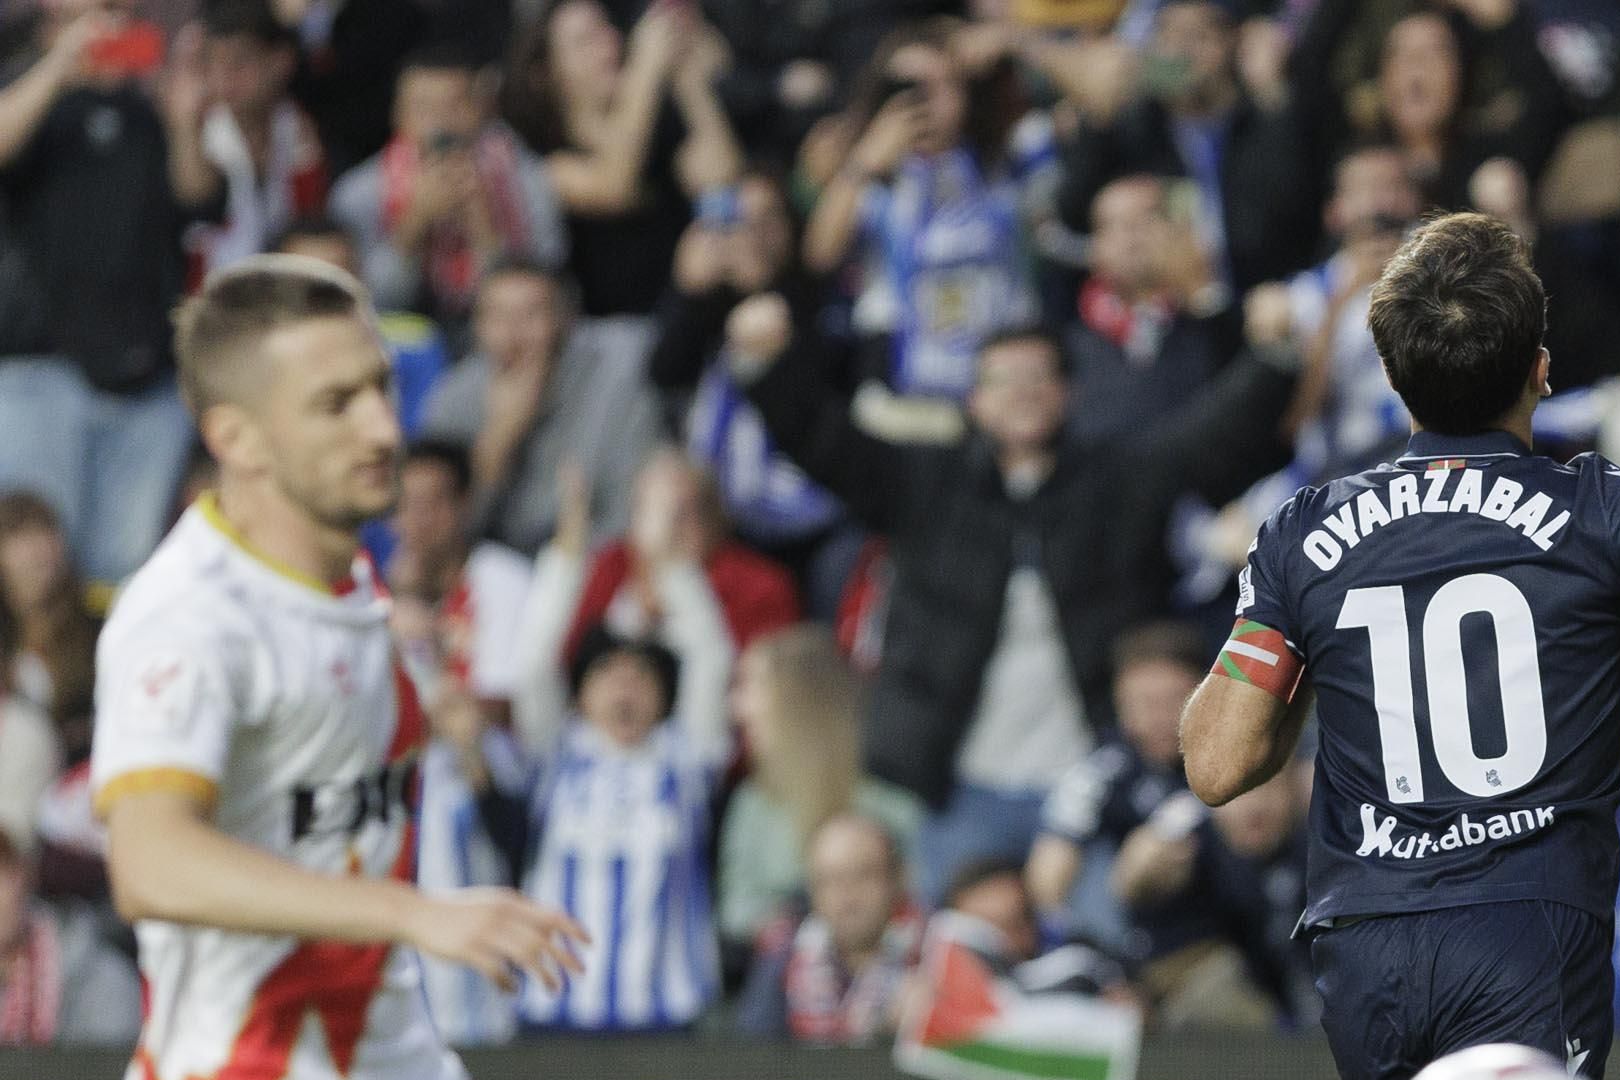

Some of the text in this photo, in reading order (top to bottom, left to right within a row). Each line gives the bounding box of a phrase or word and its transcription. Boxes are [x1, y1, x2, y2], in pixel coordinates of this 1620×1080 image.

[1302, 468, 1571, 572] OYARZABAL
[1334, 572, 1548, 805] 10
[1354, 802, 1556, 860] Kutabank
